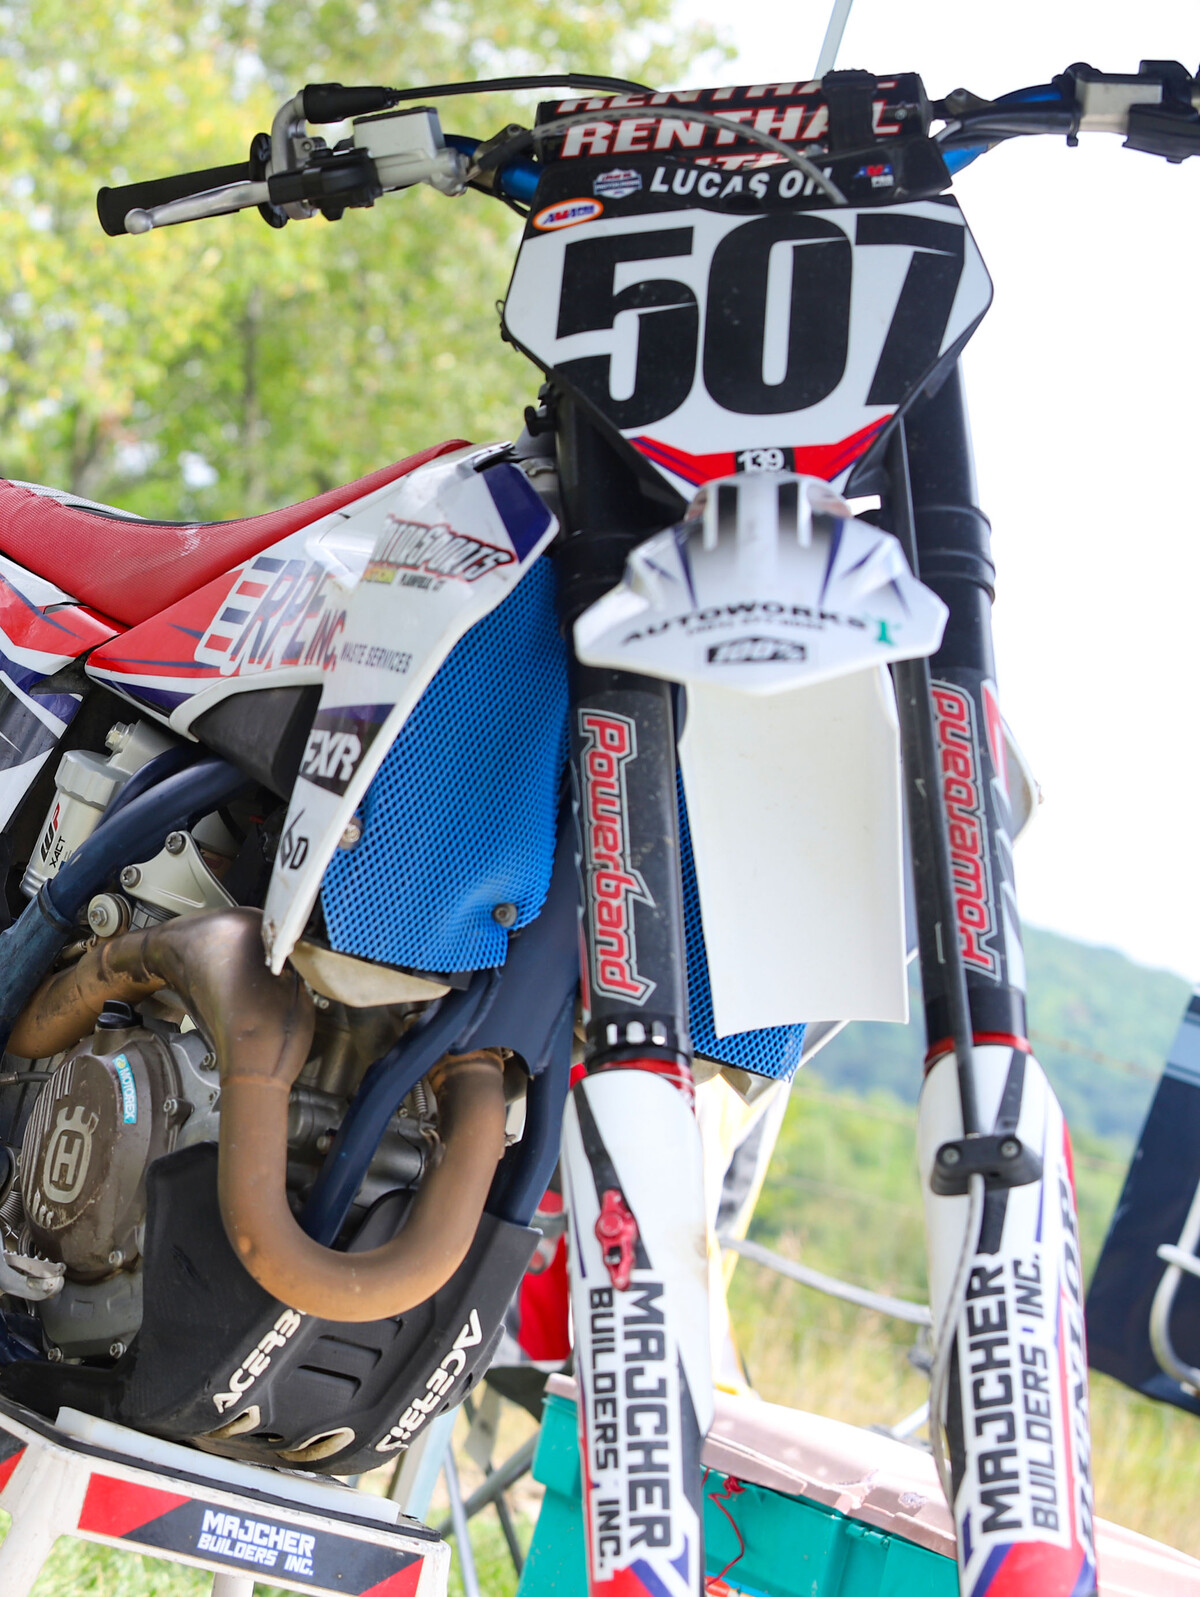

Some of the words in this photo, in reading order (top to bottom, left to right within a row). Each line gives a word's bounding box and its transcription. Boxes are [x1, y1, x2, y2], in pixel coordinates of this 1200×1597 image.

[650, 166, 770, 199] LUCAS
[553, 213, 966, 430] 507
[621, 602, 867, 646] AUTOWORKS
[299, 729, 361, 781] FXR
[49, 835, 66, 868] XACT
[582, 712, 650, 1000] Powerband
[119, 1067, 136, 1119] MOTOREX
[1012, 1253, 1044, 1319] INC.
[213, 1308, 306, 1414] ACERB
[590, 1287, 619, 1471] BUILDERS
[622, 1275, 671, 1549] MAJCHER
[966, 1260, 1023, 1533] MAJCHER
[1020, 1343, 1060, 1532] BUILDERS
[197, 1533, 279, 1567] BUILDERS
[283, 1554, 315, 1577] INC.
[201, 1509, 316, 1558] MAJCHER
[597, 1499, 622, 1568] INC.
